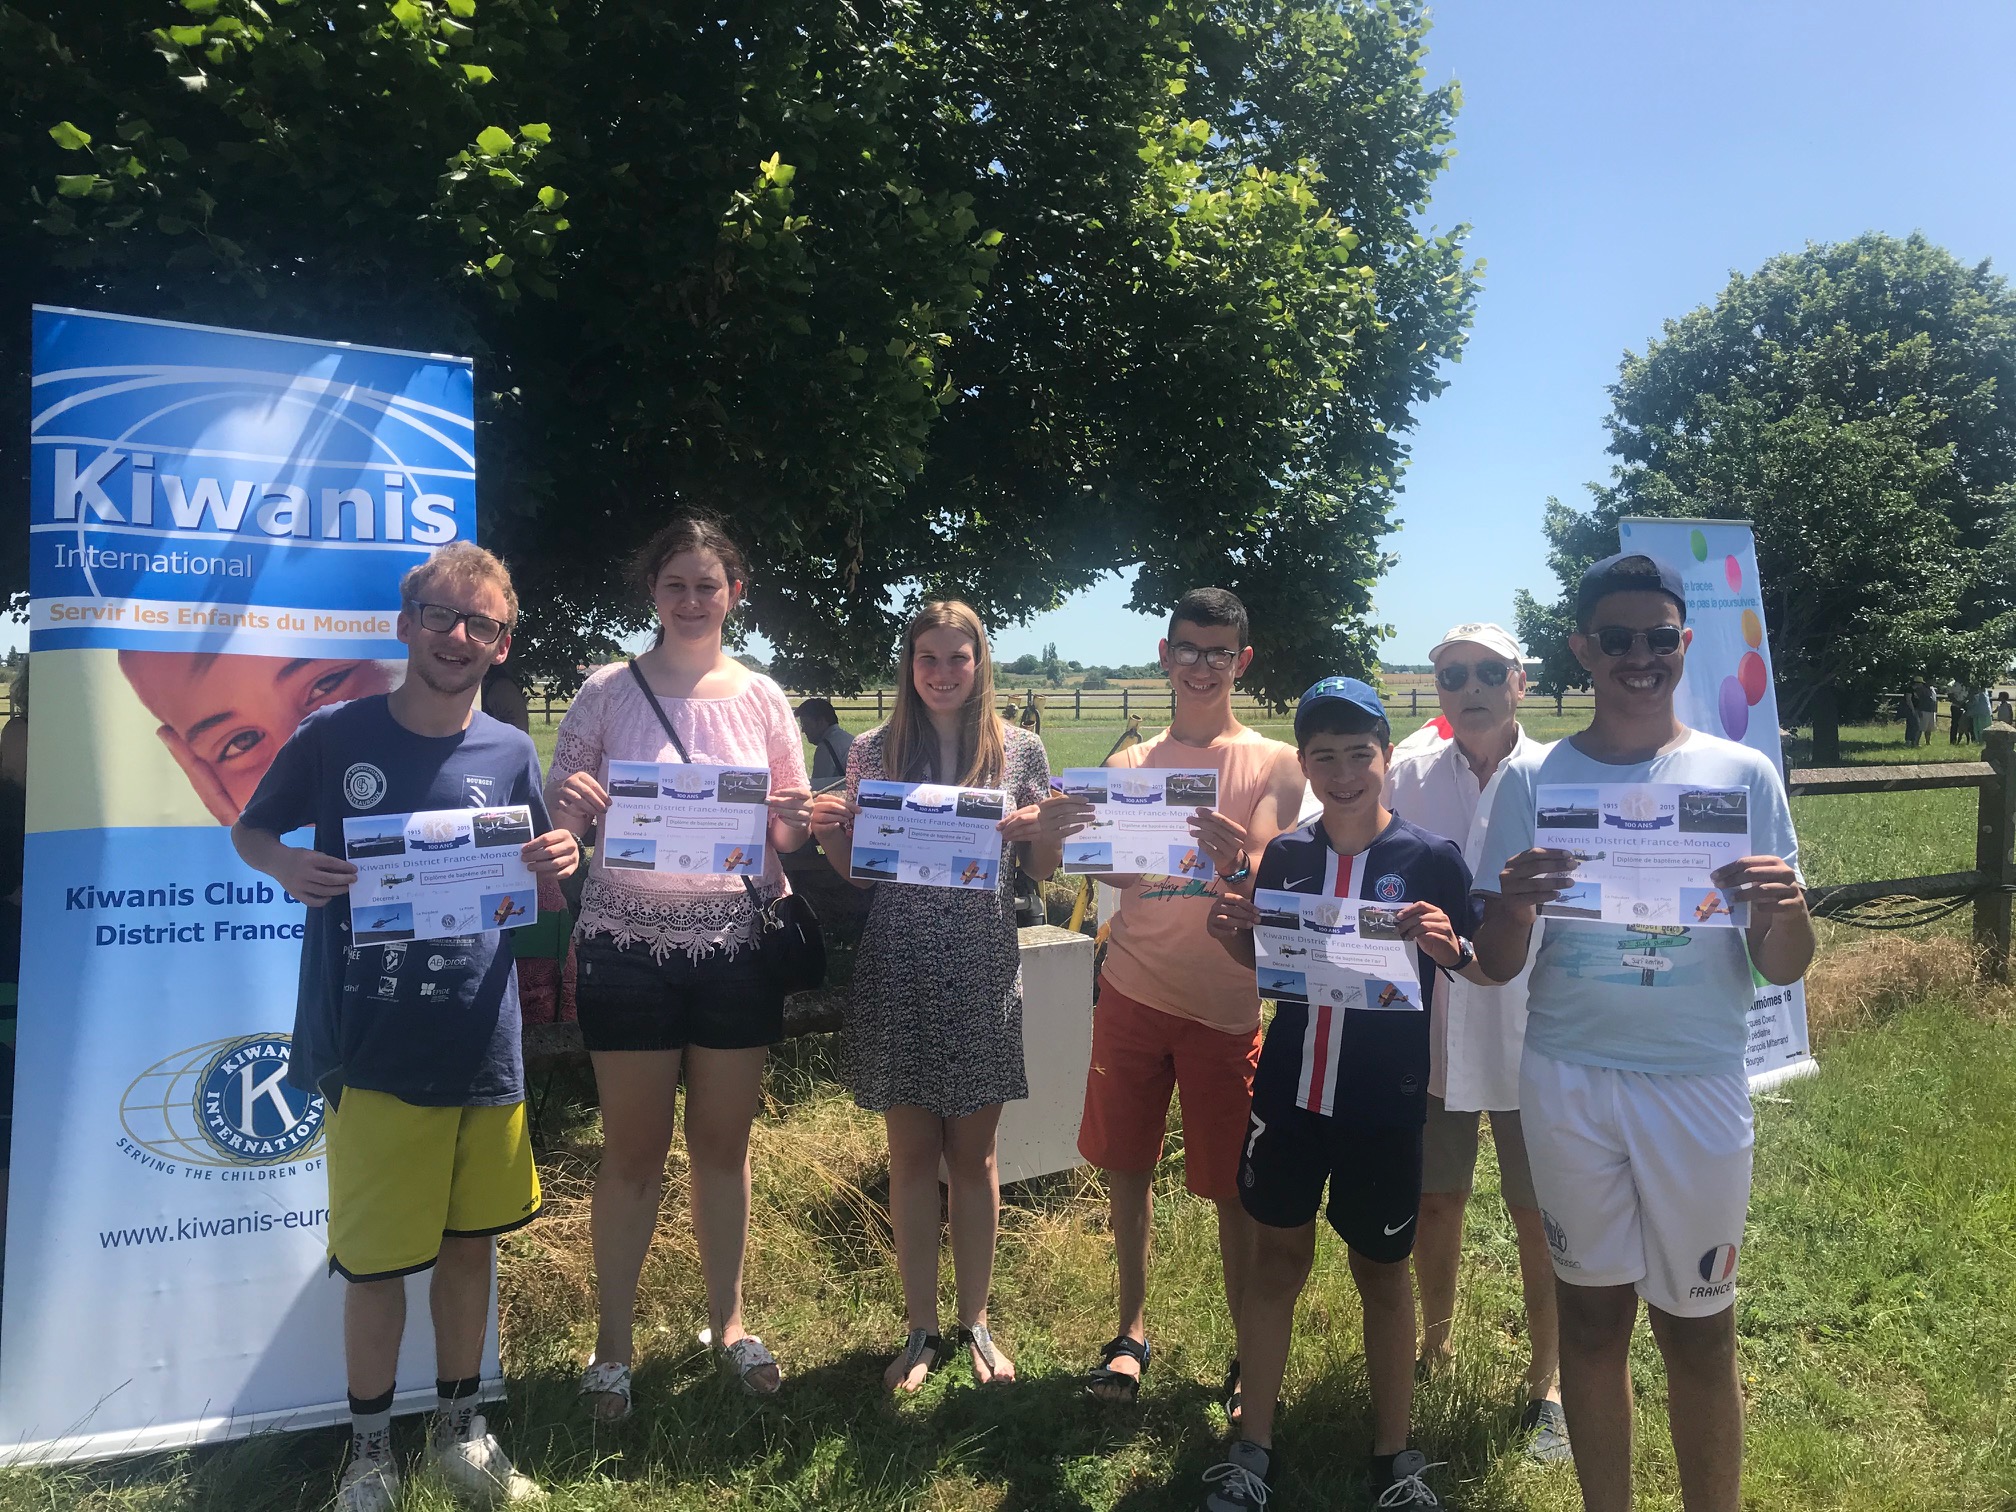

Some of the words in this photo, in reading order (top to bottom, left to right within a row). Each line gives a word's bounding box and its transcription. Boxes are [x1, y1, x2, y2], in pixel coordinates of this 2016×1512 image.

[54, 448, 459, 545] Kiwanis
[54, 544, 253, 578] International
[50, 603, 129, 625] Servir
[134, 604, 170, 625] les
[178, 608, 270, 630] Enfants
[276, 610, 306, 631] du
[314, 615, 391, 634] Monde
[616, 802, 651, 810] Kiwanis
[654, 804, 686, 812] District
[688, 805, 754, 814] France-Monaco
[864, 812, 895, 821] Kiwanis
[898, 816, 926, 824] District
[928, 818, 990, 830] France-Monaco
[1547, 836, 1590, 844] Kiwanis
[1594, 836, 1637, 846] District
[1640, 838, 1731, 848] France-Monaco
[360, 862, 400, 872] Kiwanis
[403, 858, 440, 868] District
[444, 850, 519, 864] France-Monaco
[1616, 856, 1642, 864] Diplôme
[1653, 858, 1680, 866] baptême
[65, 882, 195, 911] Kiwanis
[204, 882, 275, 906] Club
[96, 922, 205, 946] District
[1262, 932, 1295, 942] Kiwanis
[1298, 936, 1328, 946] District
[1332, 940, 1400, 952] France-Monaco
[1783, 990, 1792, 1002] 18
[206, 1091, 324, 1154] INTERNATIONA
[116, 1137, 177, 1176] SERVING
[184, 1168, 213, 1181] THE
[222, 1166, 296, 1182] CHILDREN
[305, 1159, 322, 1172] OF
[1689, 1282, 1732, 1298] FRANCE
